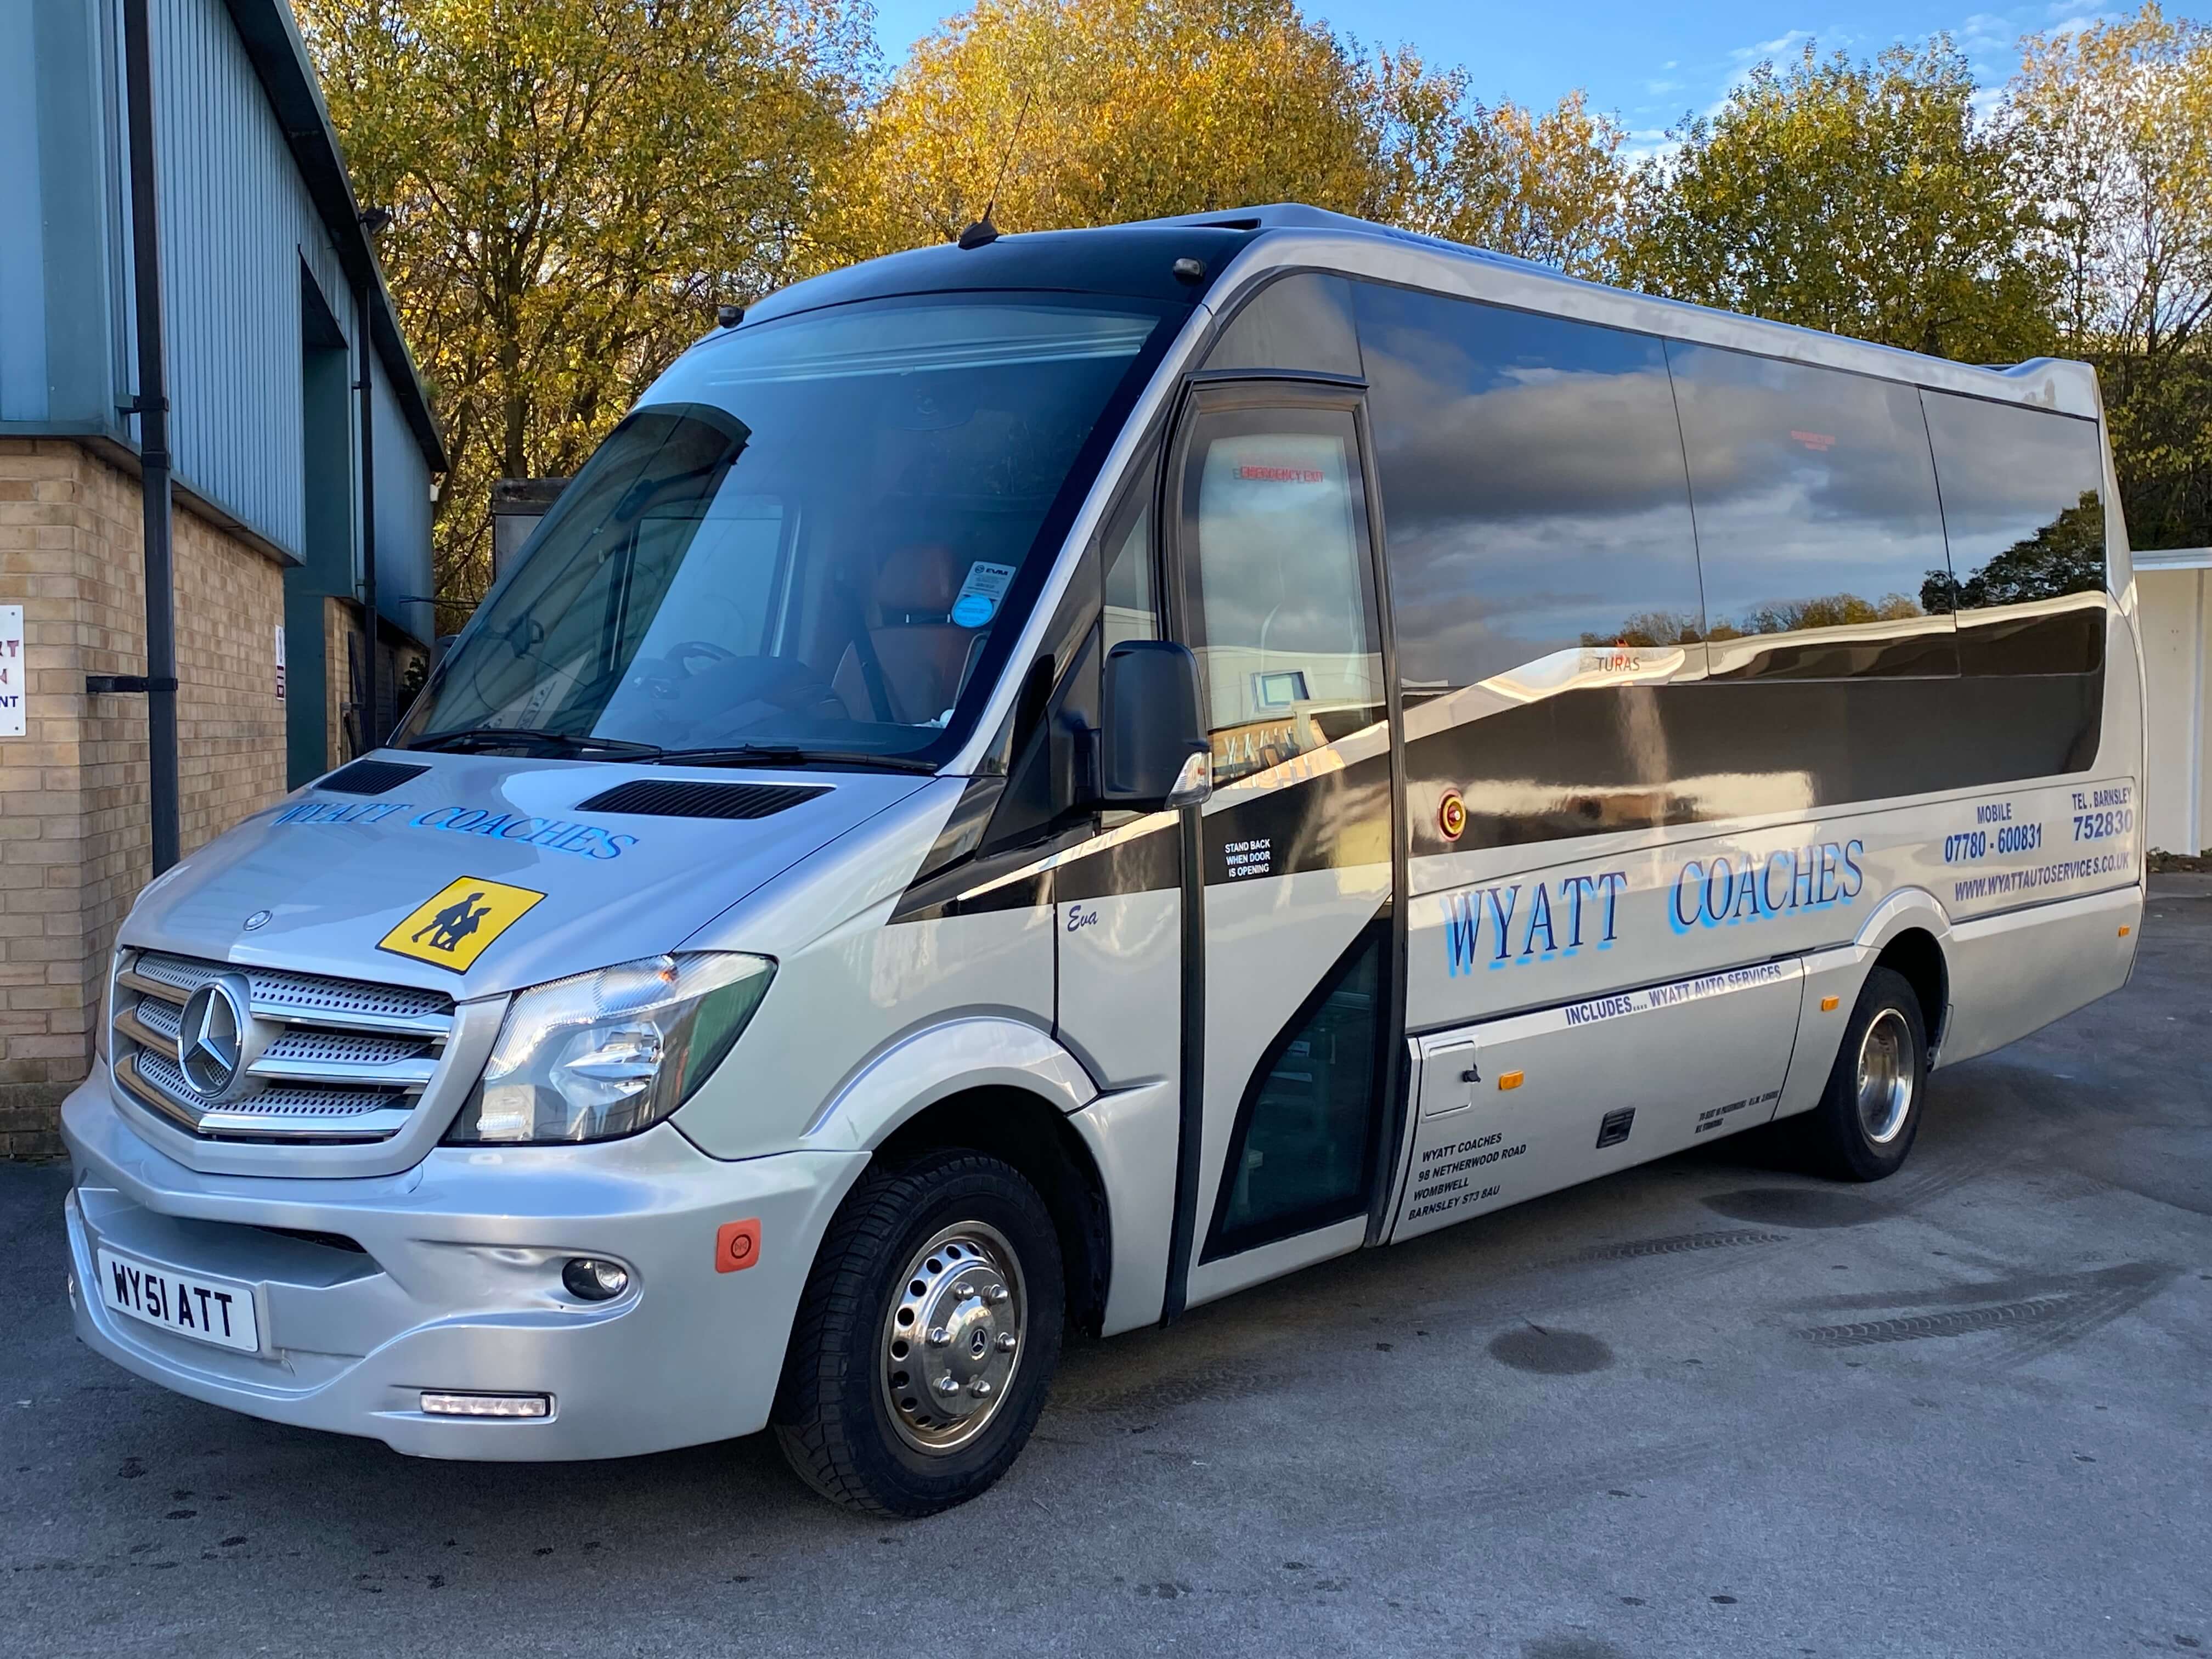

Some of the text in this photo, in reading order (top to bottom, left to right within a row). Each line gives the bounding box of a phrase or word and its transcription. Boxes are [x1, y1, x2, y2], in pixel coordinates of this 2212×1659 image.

[1595, 657, 1641, 673] TURAS
[2094, 787, 2132, 808] BARNSLEY
[1977, 803, 2012, 824] MOBILE
[2073, 809, 2134, 842] 752830
[273, 803, 640, 861] WYATT COACHES
[1224, 838, 1271, 854] STAND BACK
[1945, 831, 1987, 864] 07780
[1998, 822, 2042, 855] 600831
[1226, 850, 1271, 866] WHEN DOOR
[1228, 863, 1269, 878] IS OPENING
[1067, 905, 1098, 932] Eva
[1440, 839, 1865, 979] WYATT COACHES
[1648, 983, 1691, 1007] WYATT
[1694, 976, 1726, 997] AUTO
[1726, 964, 1781, 990] SERVICES
[1418, 1144, 1527, 1182] 98 NETHERWOOD ROAD
[1422, 1132, 1503, 1163] WYATT COACHES
[1408, 1184, 1500, 1221] BARNSLEY S73 8AU
[1413, 1177, 1469, 1201] WOMBWELL
[178, 1283, 233, 1338] ATT
